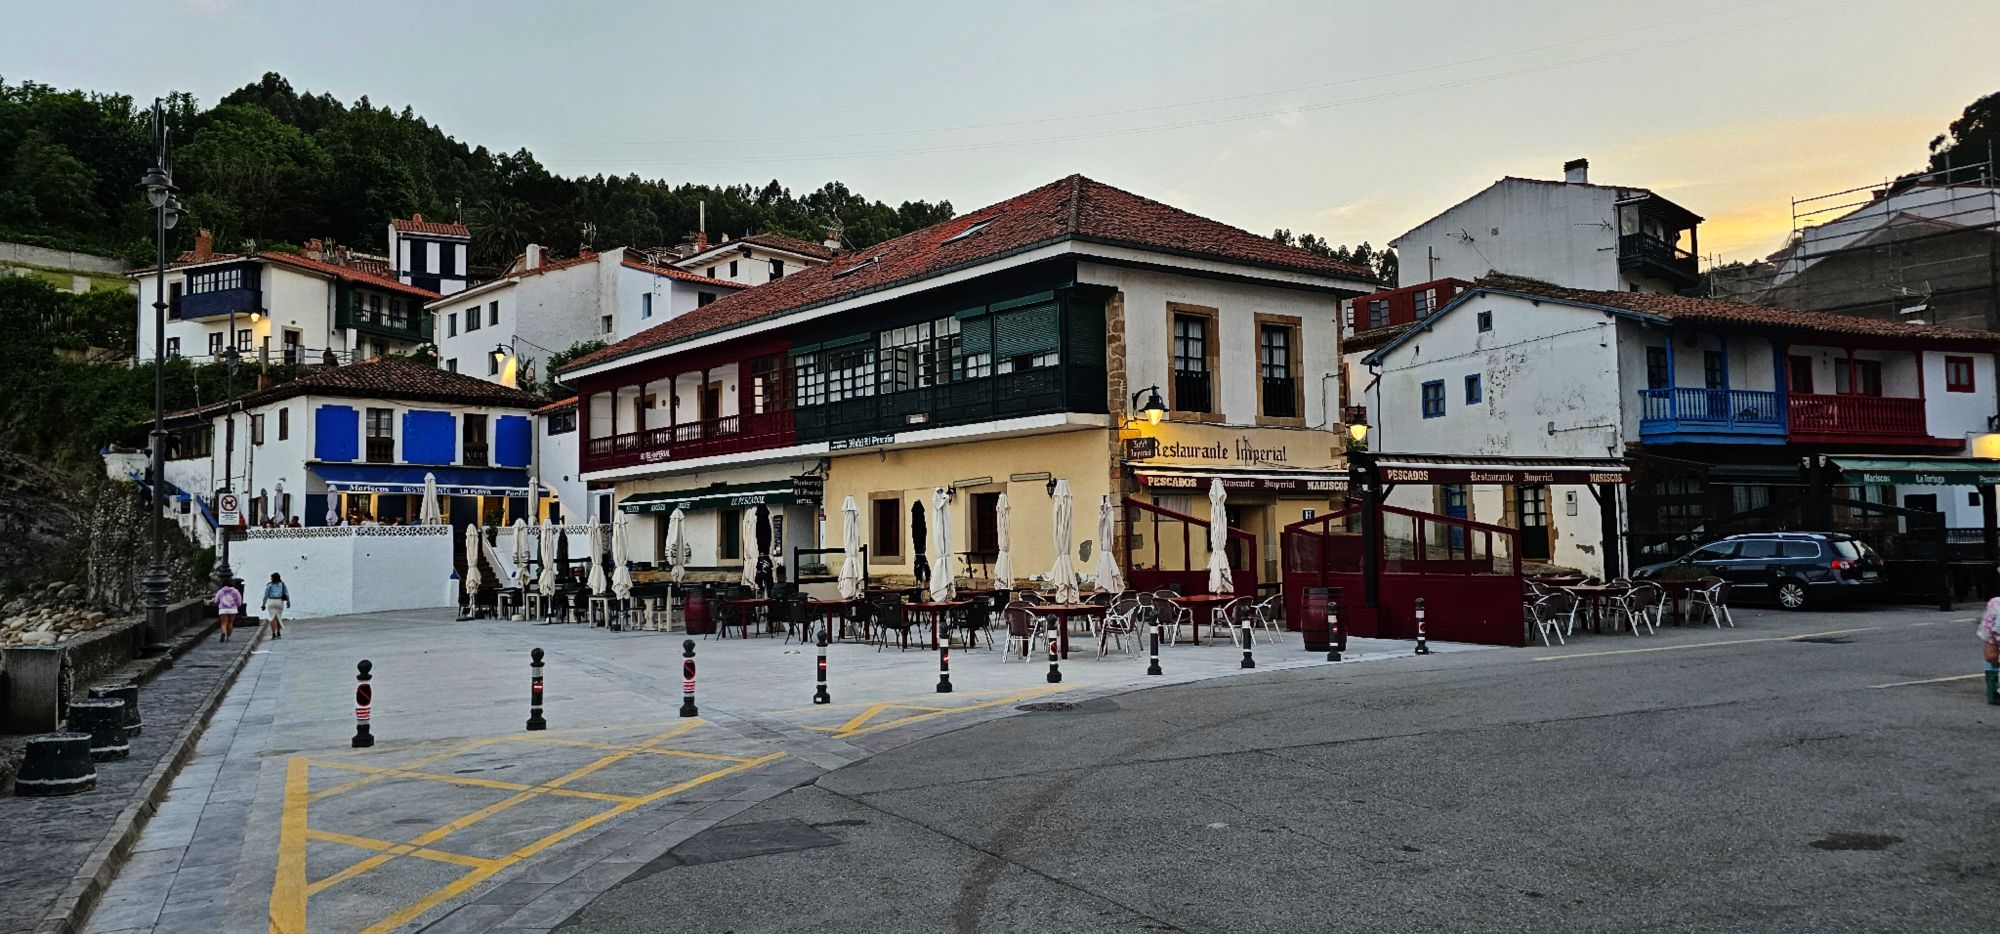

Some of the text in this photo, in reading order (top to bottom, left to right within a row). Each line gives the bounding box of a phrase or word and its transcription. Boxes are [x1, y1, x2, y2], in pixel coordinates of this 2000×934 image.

[1235, 438, 1287, 465] Imperial
[1387, 469, 1623, 483] PESCADOS Restaurante Imperial MARISCOS
[1863, 473, 1891, 483] Mariscos
[1915, 474, 1924, 483] La
[350, 484, 390, 493] Mariscos
[1146, 476, 1197, 487] PESCADOS
[1263, 479, 1296, 490] Imperial
[1307, 481, 1349, 491] MARISCOS
